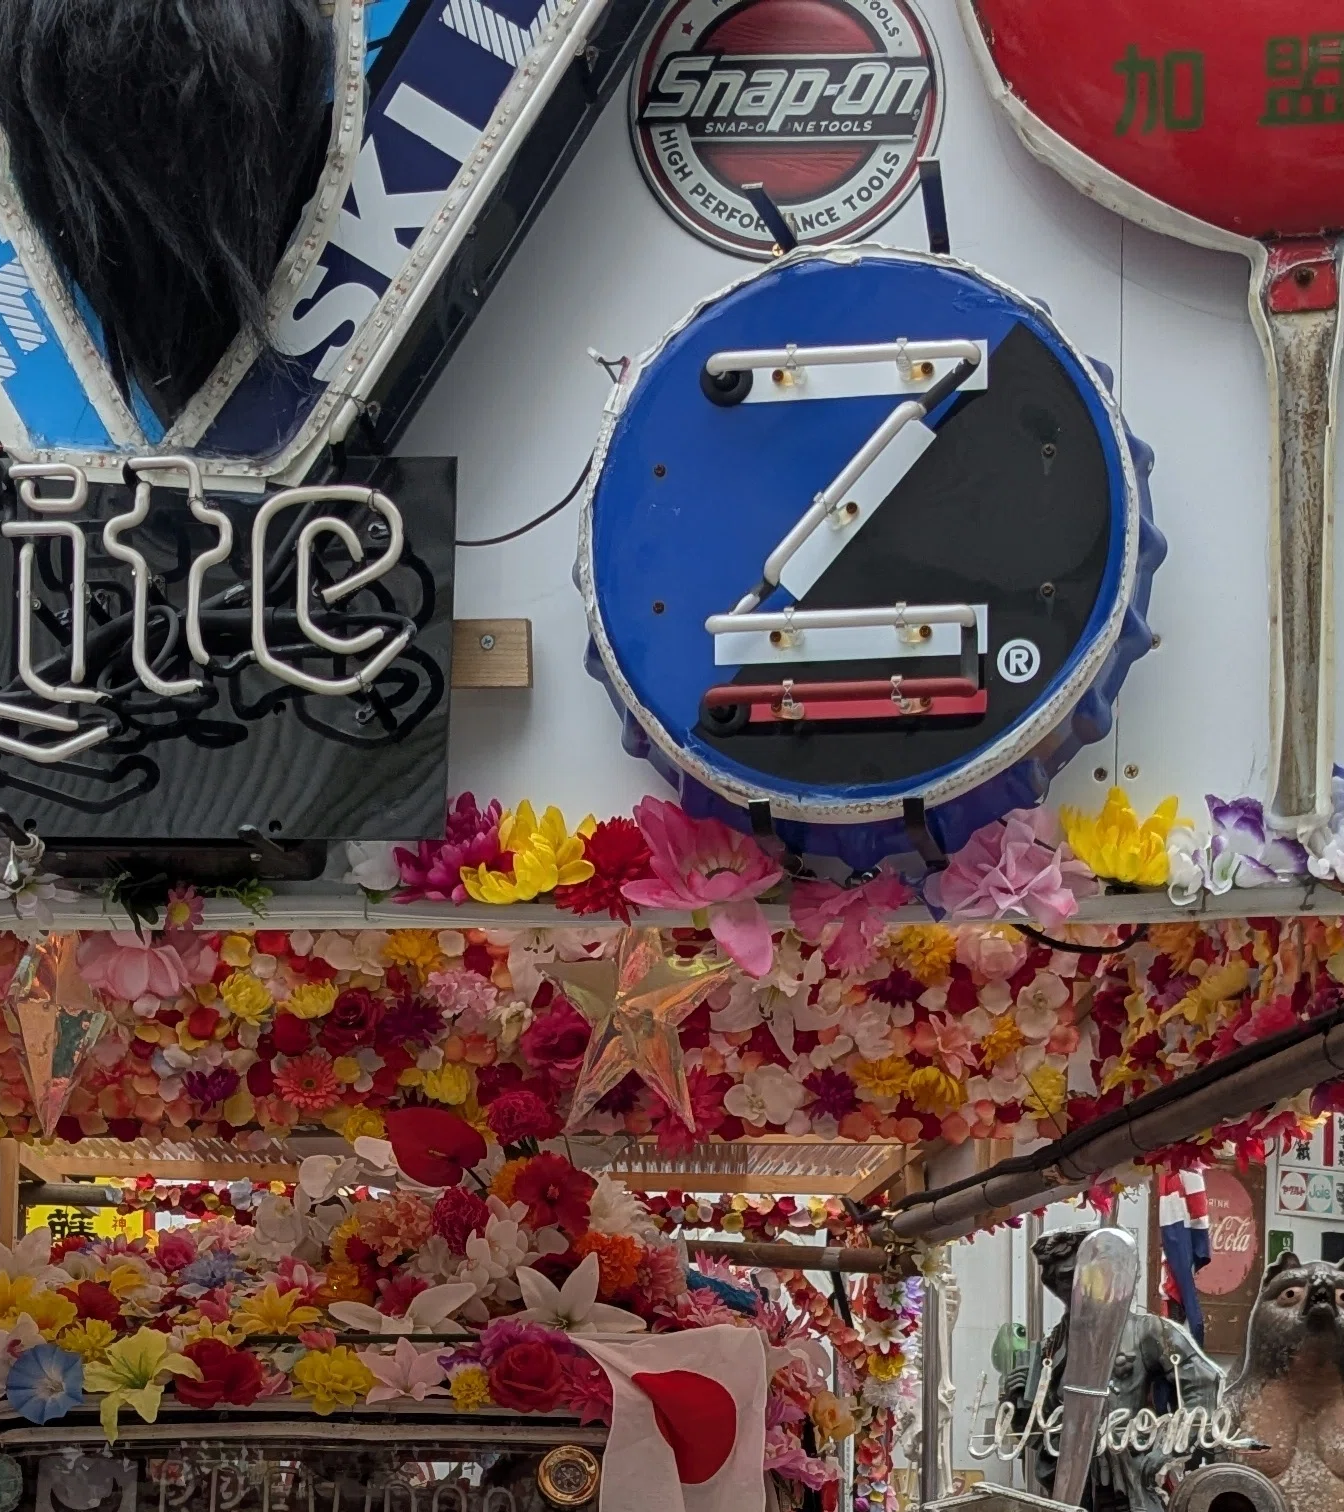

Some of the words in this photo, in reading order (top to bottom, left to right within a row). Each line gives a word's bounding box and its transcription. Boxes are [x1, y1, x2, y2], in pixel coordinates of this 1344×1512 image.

[642, 58, 931, 132] Snap-On
[659, 128, 694, 183] HIGH
[687, 182, 842, 234] PERFORNCE
[842, 149, 902, 213] TOOLS
